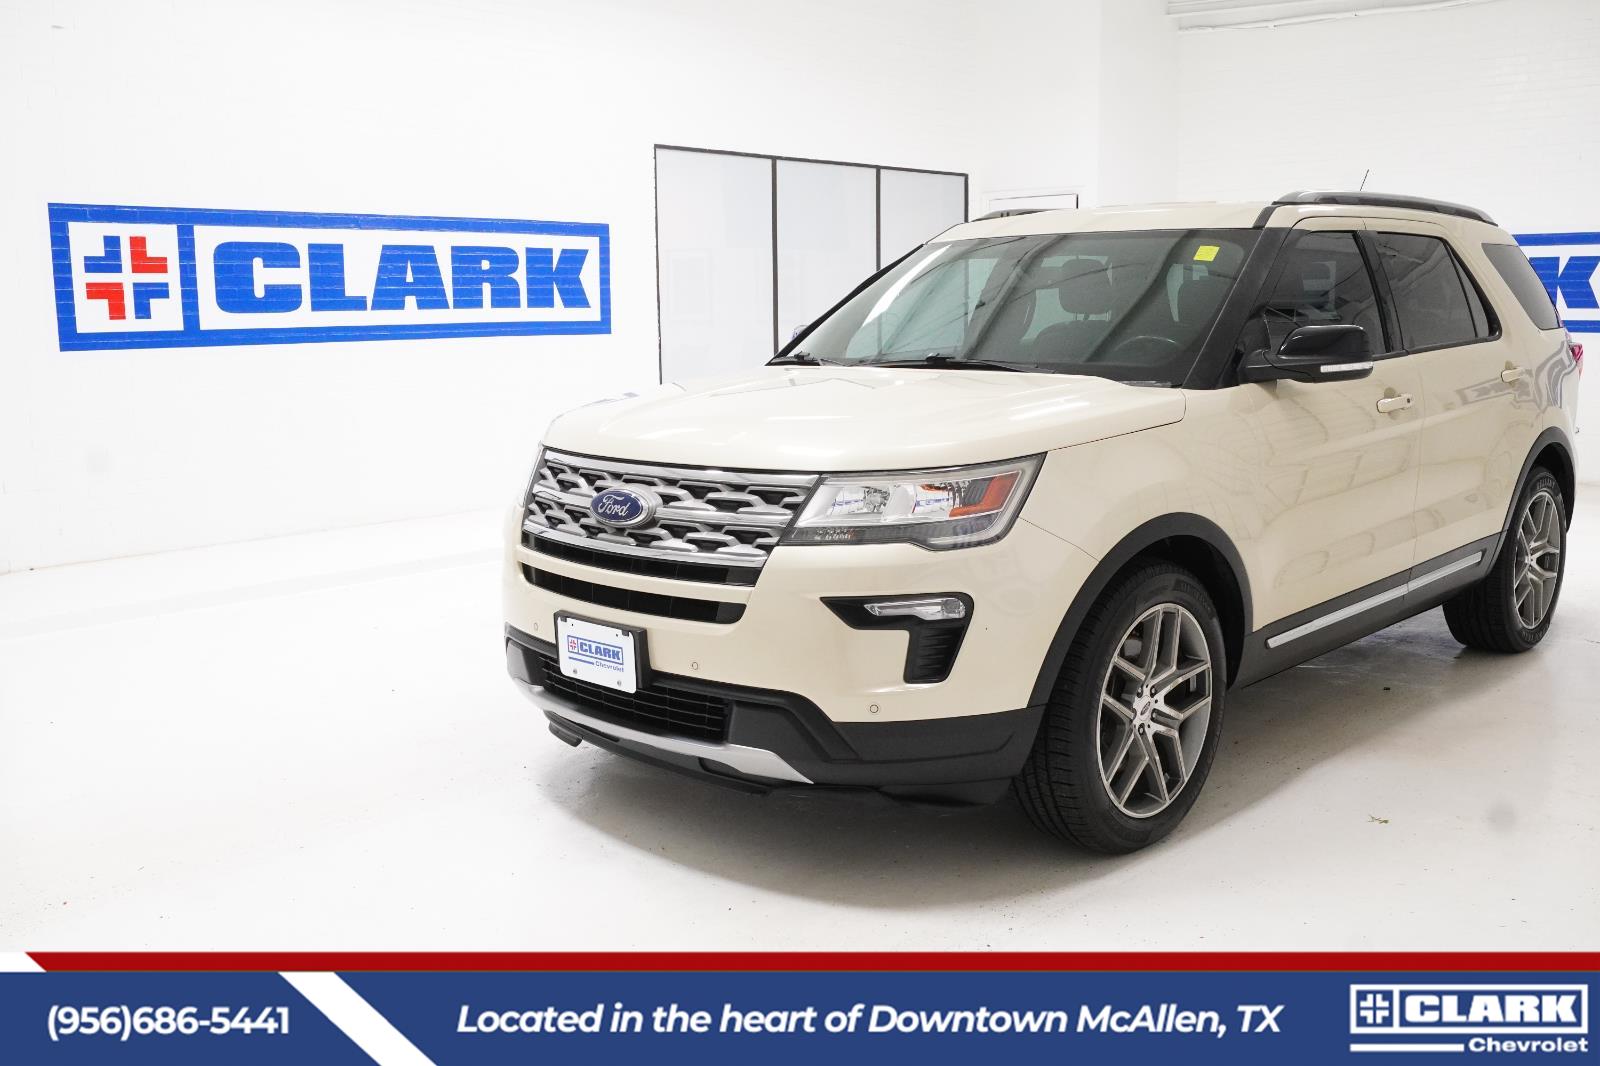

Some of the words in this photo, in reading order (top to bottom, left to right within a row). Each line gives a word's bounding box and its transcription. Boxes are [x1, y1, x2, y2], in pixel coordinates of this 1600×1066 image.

[213, 241, 591, 314] CLARK
[598, 494, 631, 517] Ford
[579, 641, 622, 661] CLARK
[595, 660, 624, 673] Chevrolet
